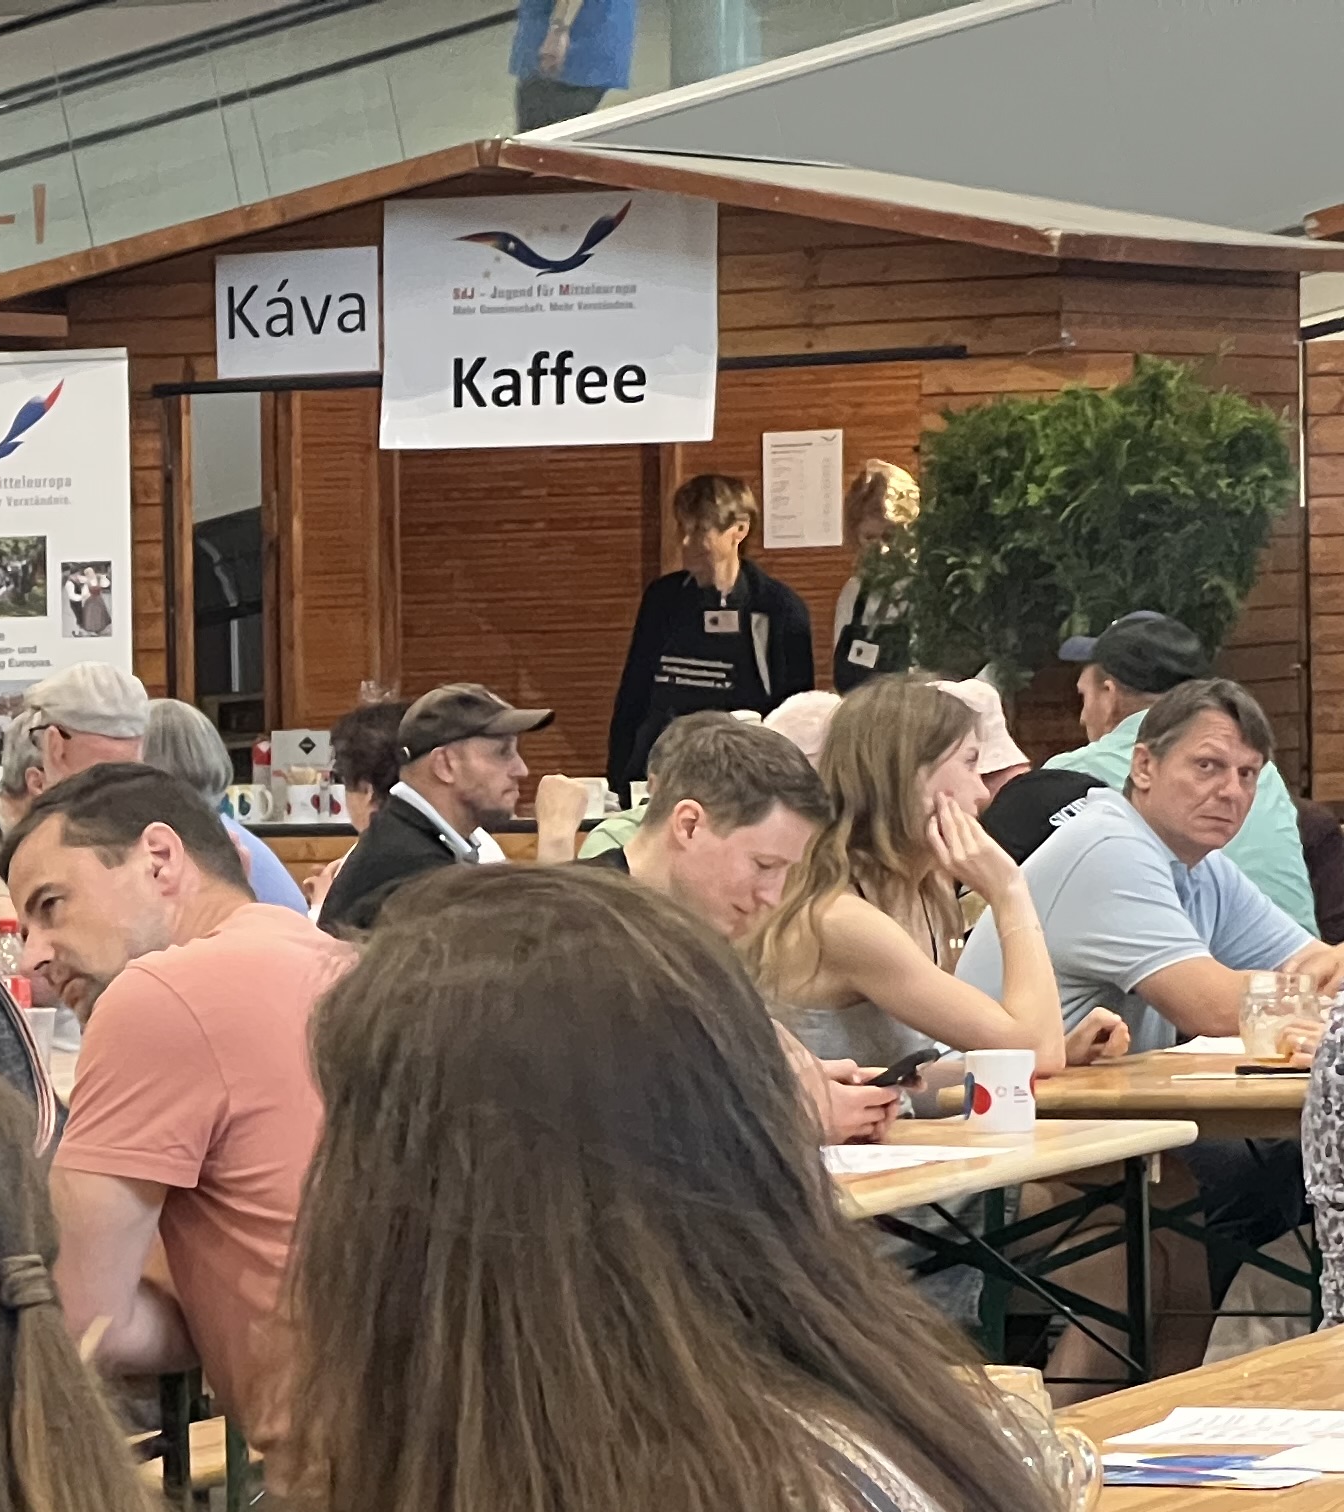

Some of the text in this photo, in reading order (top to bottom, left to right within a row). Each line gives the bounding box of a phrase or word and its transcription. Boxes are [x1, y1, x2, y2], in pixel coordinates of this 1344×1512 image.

[227, 278, 366, 339] Káva
[452, 350, 647, 409] Kaffee
[17, 645, 38, 655] und
